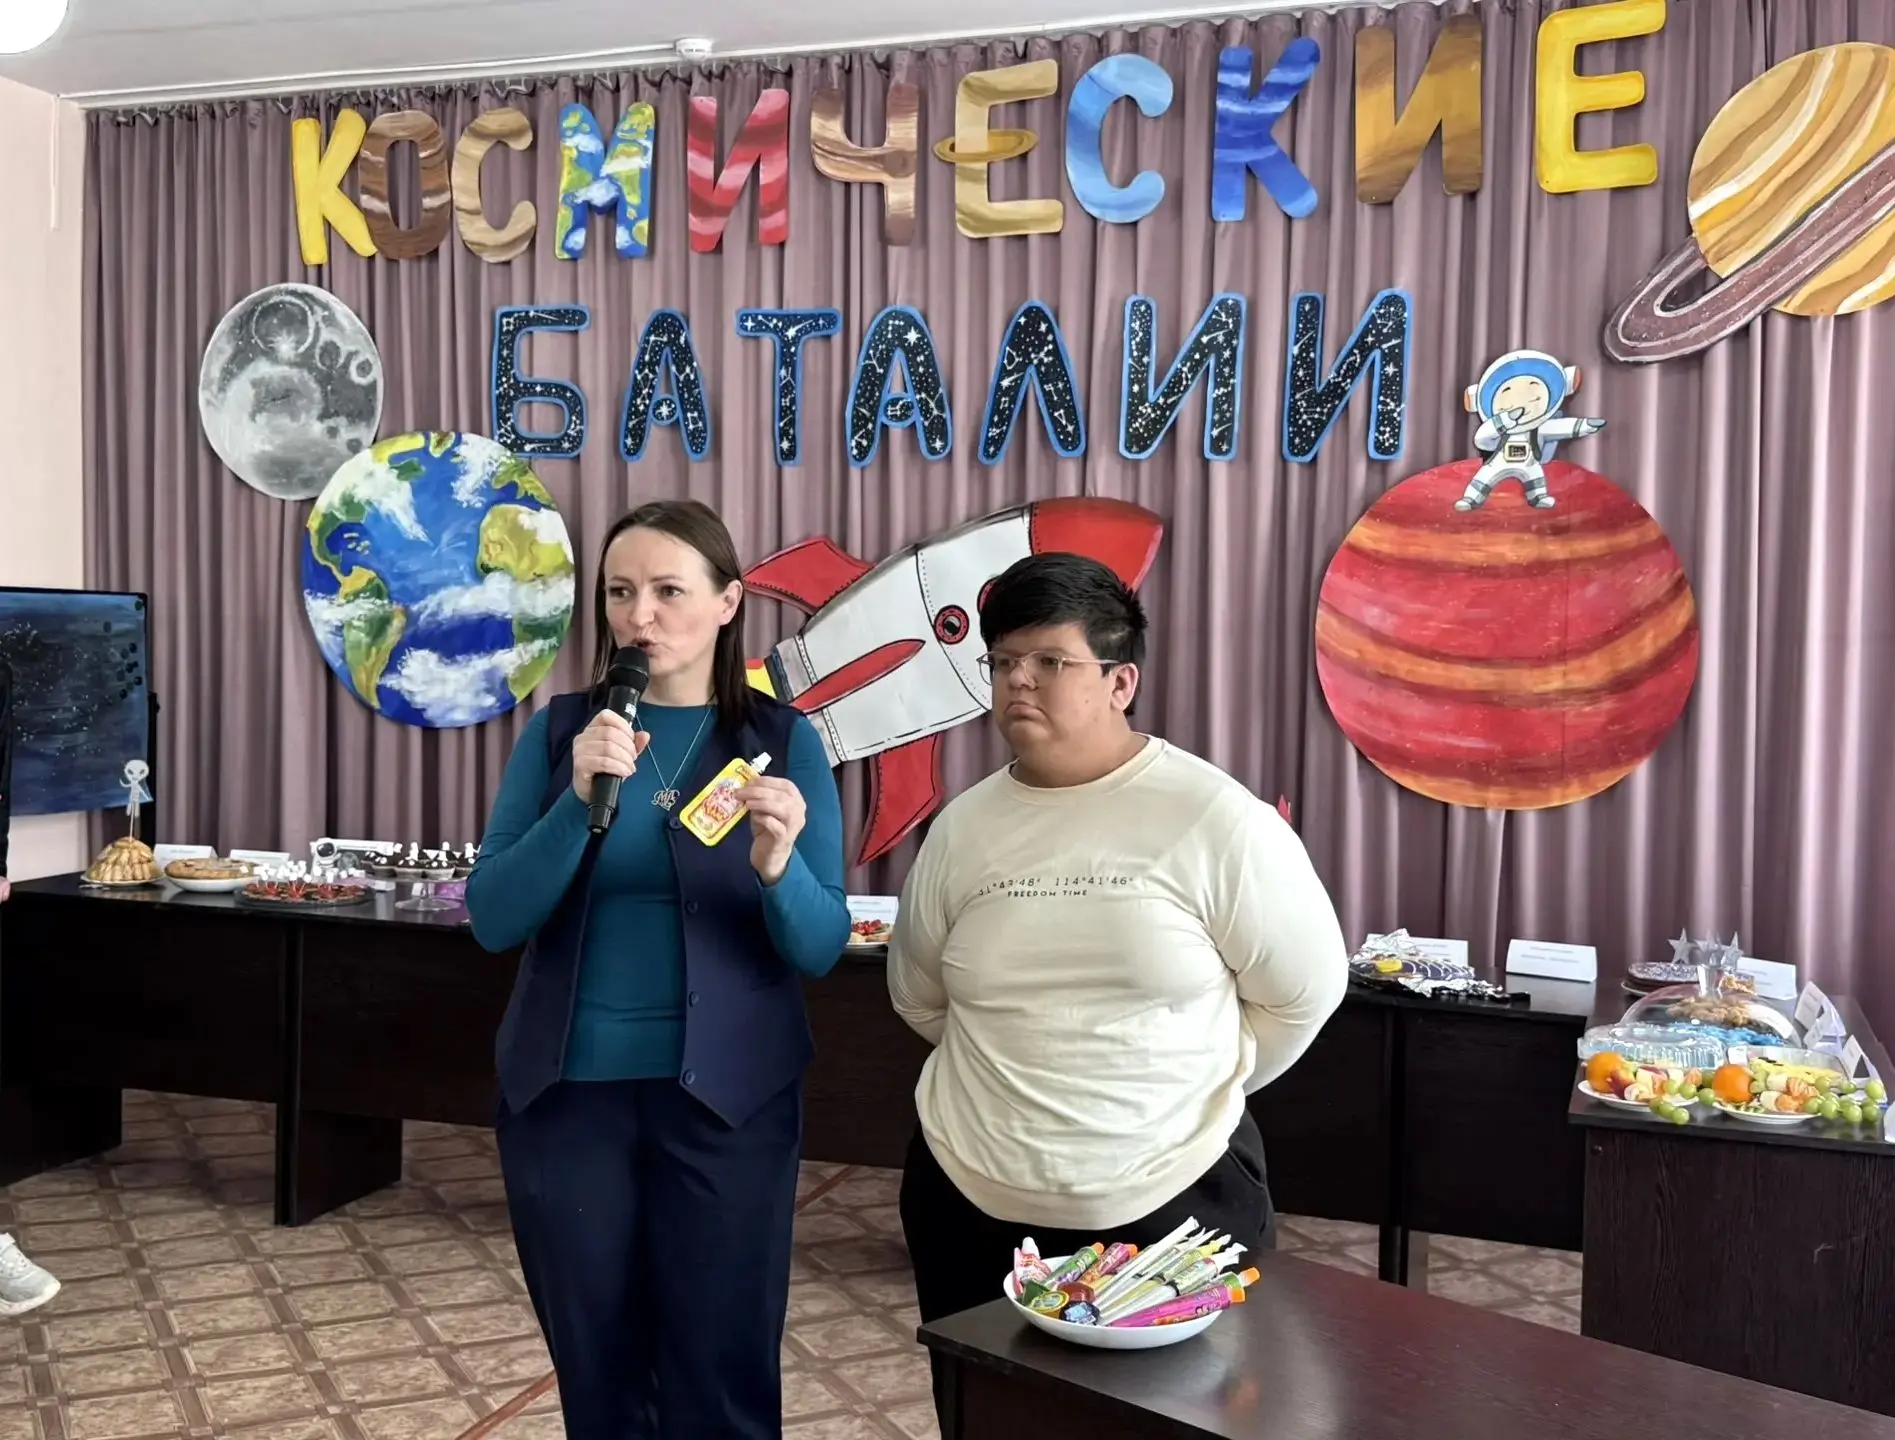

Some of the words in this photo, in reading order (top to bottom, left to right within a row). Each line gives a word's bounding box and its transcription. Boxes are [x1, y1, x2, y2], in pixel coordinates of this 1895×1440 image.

[291, 0, 1666, 266] КОСМИЧЕСКИЕ
[491, 287, 1412, 468] БАТАЛИИ
[1007, 890, 1057, 898] FREEDOM
[1063, 889, 1088, 897] TIME
